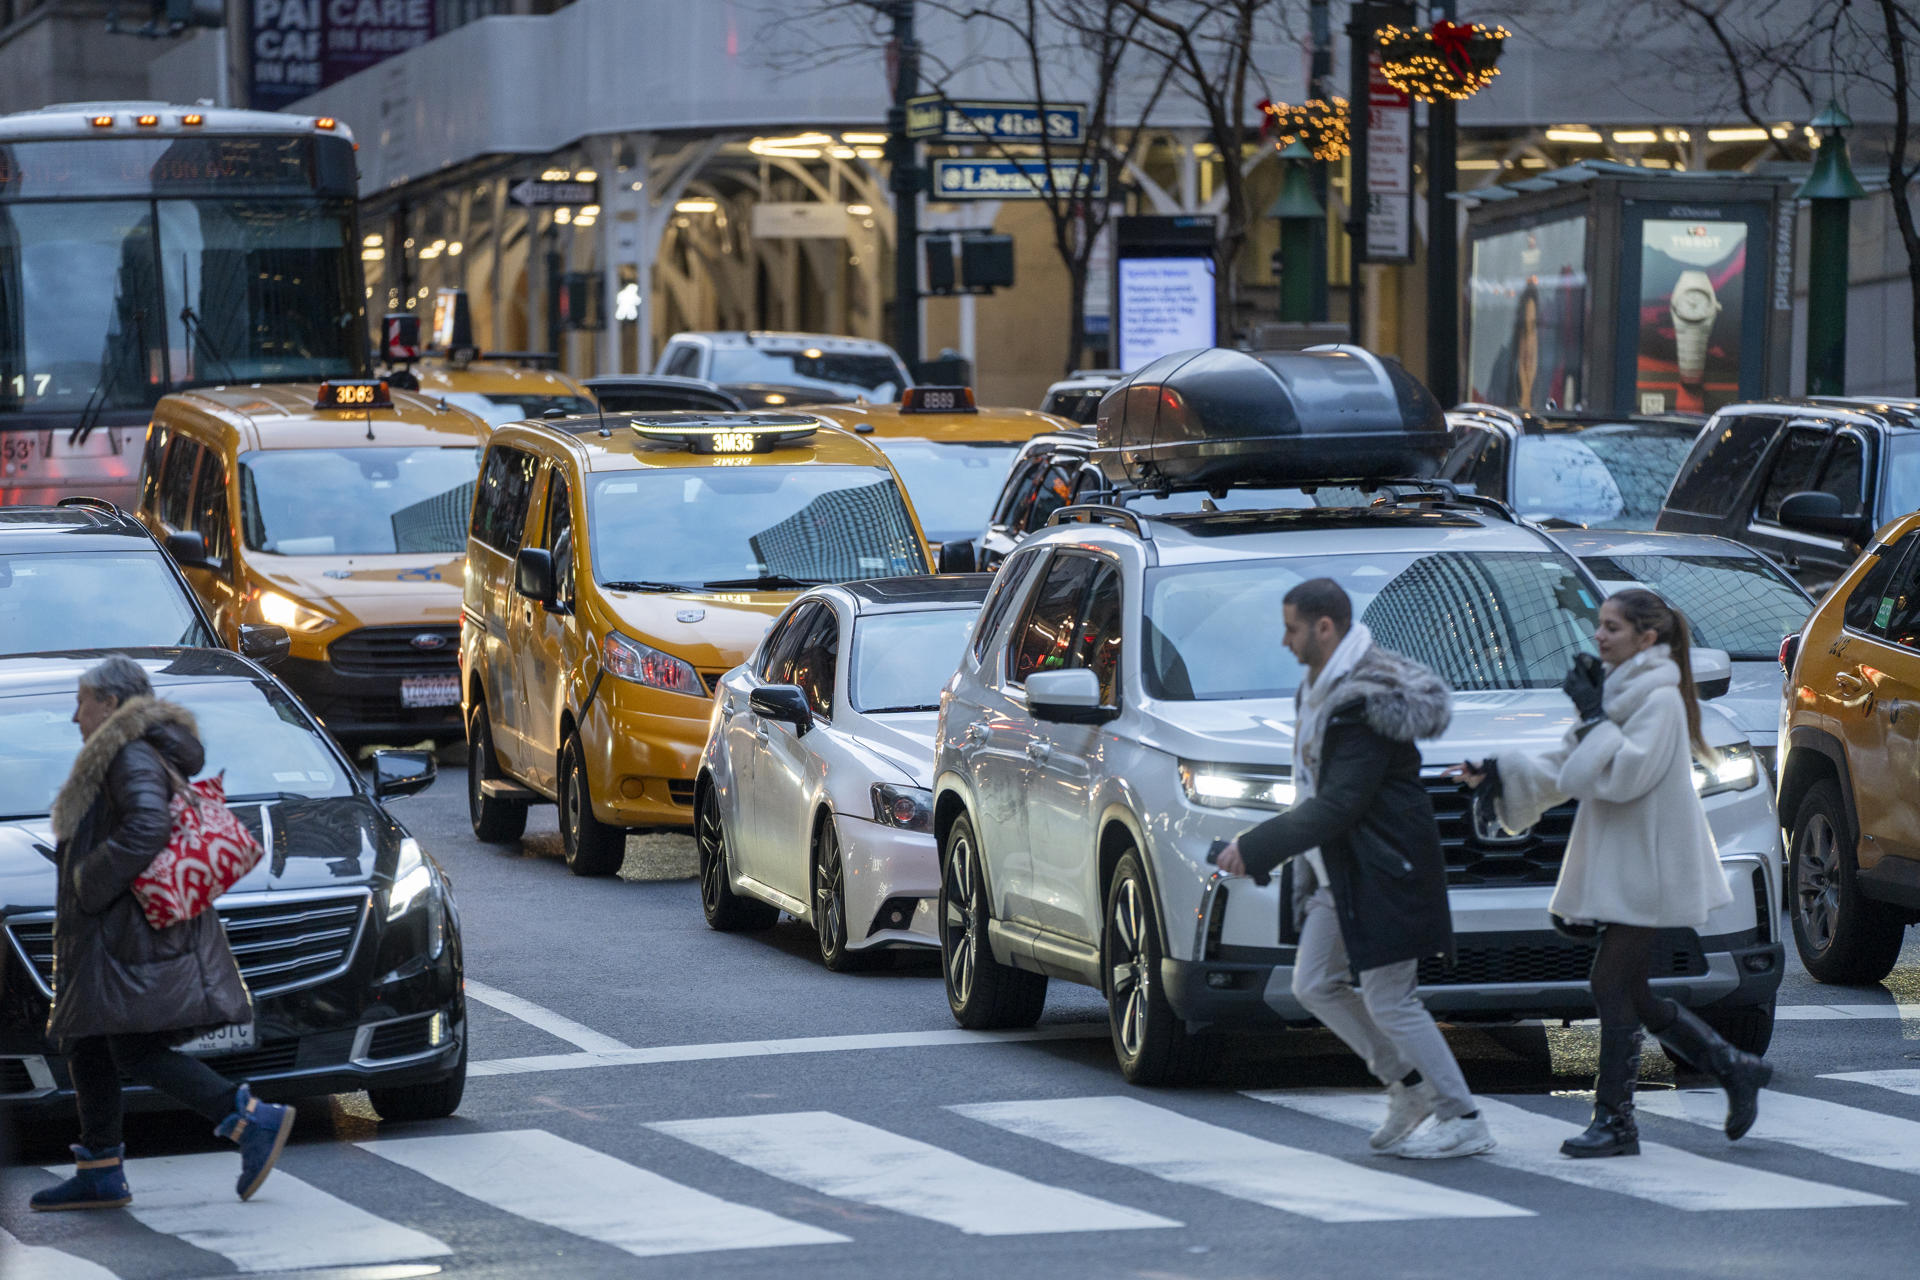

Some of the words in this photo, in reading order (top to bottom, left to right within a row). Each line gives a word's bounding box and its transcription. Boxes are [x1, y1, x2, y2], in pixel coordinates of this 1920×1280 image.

[327, 0, 430, 26] CARE
[946, 110, 996, 134] East
[1047, 113, 1072, 136] St
[1774, 200, 1797, 310] Newsstand
[336, 385, 374, 404] 3D63
[924, 391, 954, 409] 8B89
[712, 433, 754, 452] 3M36
